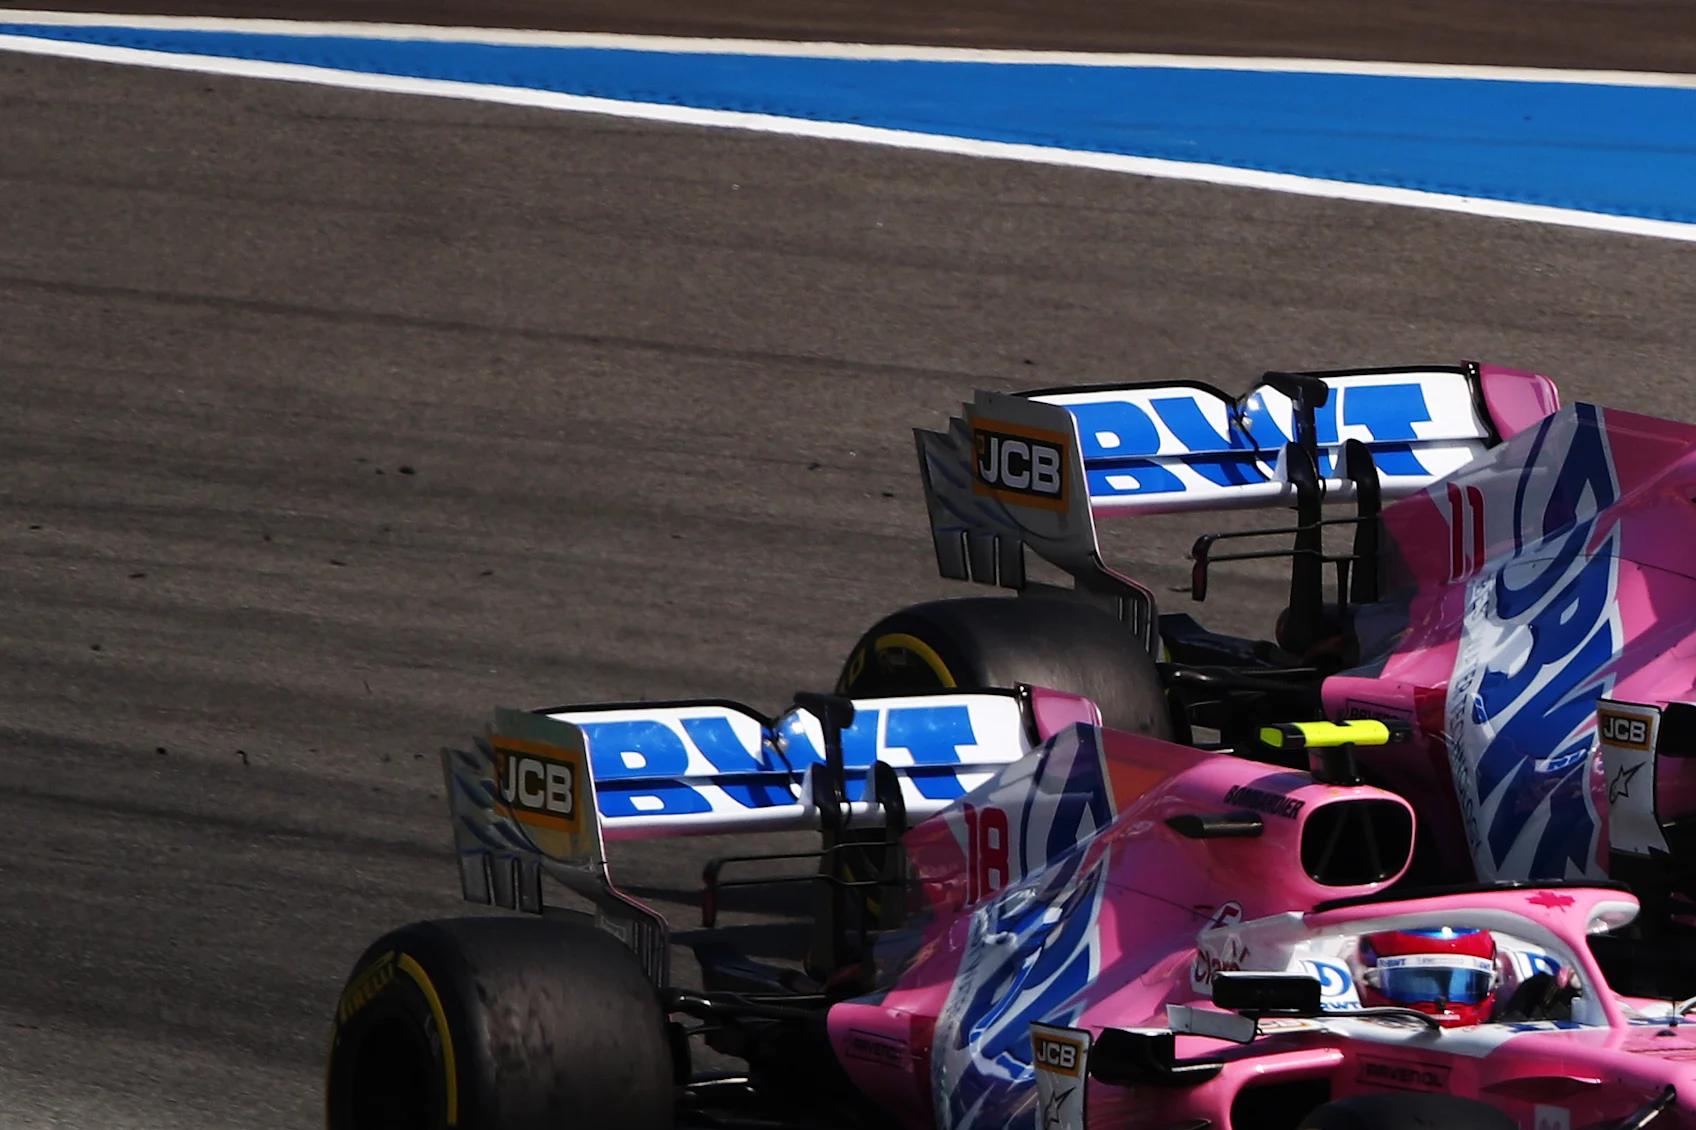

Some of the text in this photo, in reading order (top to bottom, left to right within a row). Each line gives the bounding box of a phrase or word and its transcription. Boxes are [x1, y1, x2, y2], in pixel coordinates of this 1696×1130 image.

[977, 440, 1062, 494] JCB
[1062, 383, 1434, 496] BWT
[1447, 482, 1486, 583] 11
[590, 704, 978, 818] BWT
[1604, 711, 1645, 744] JCB
[502, 756, 574, 815] JCB
[964, 803, 1010, 907] 18
[1036, 1040, 1076, 1069] JCB
